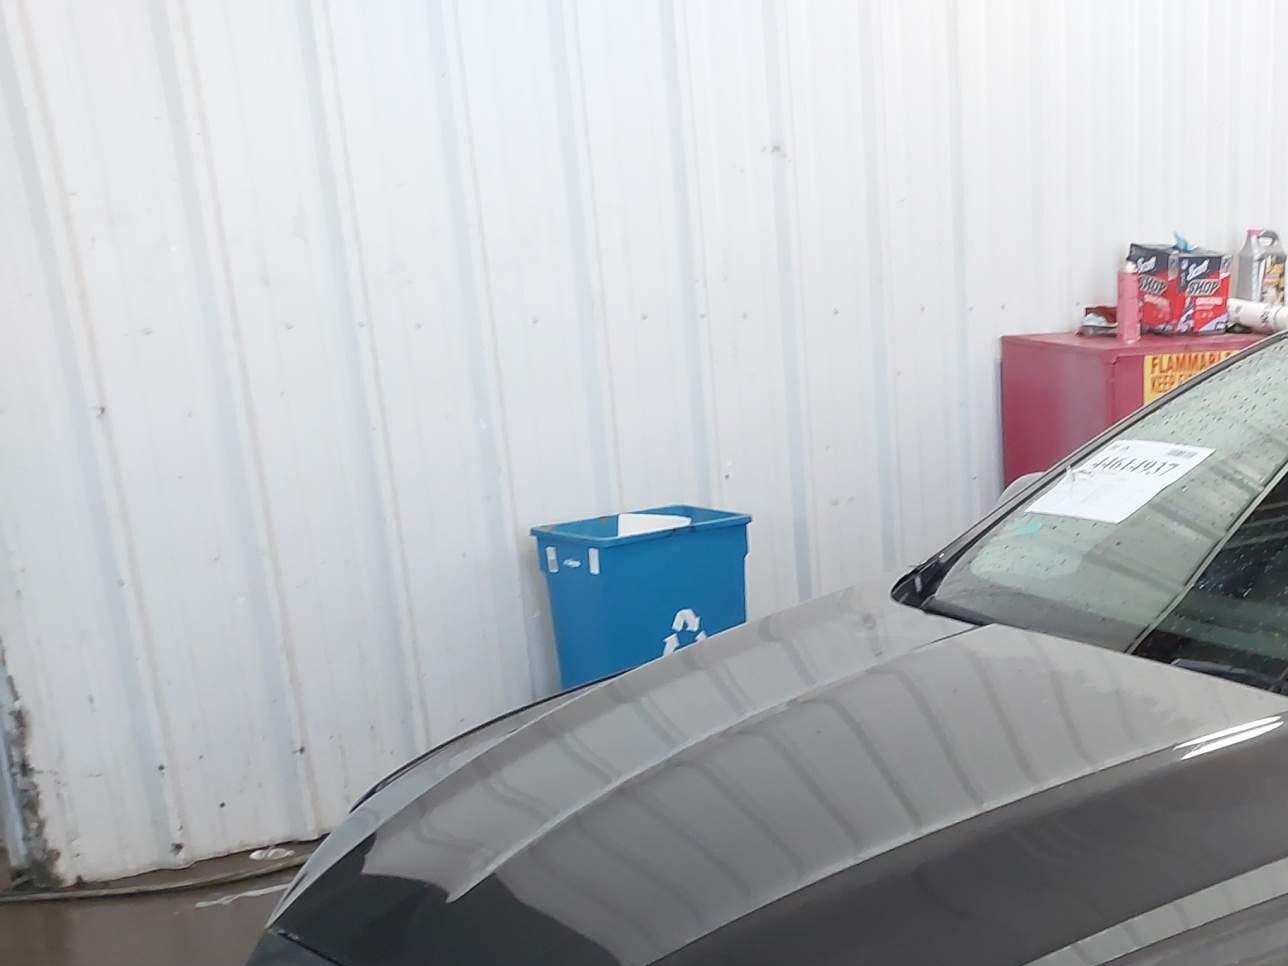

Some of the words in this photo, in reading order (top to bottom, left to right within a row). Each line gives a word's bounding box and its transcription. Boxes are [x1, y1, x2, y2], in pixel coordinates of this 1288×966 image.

[1186, 279, 1221, 297] SHOP
[1151, 352, 1232, 374] FLAMMAB
[1092, 456, 1179, 478] 44614937
